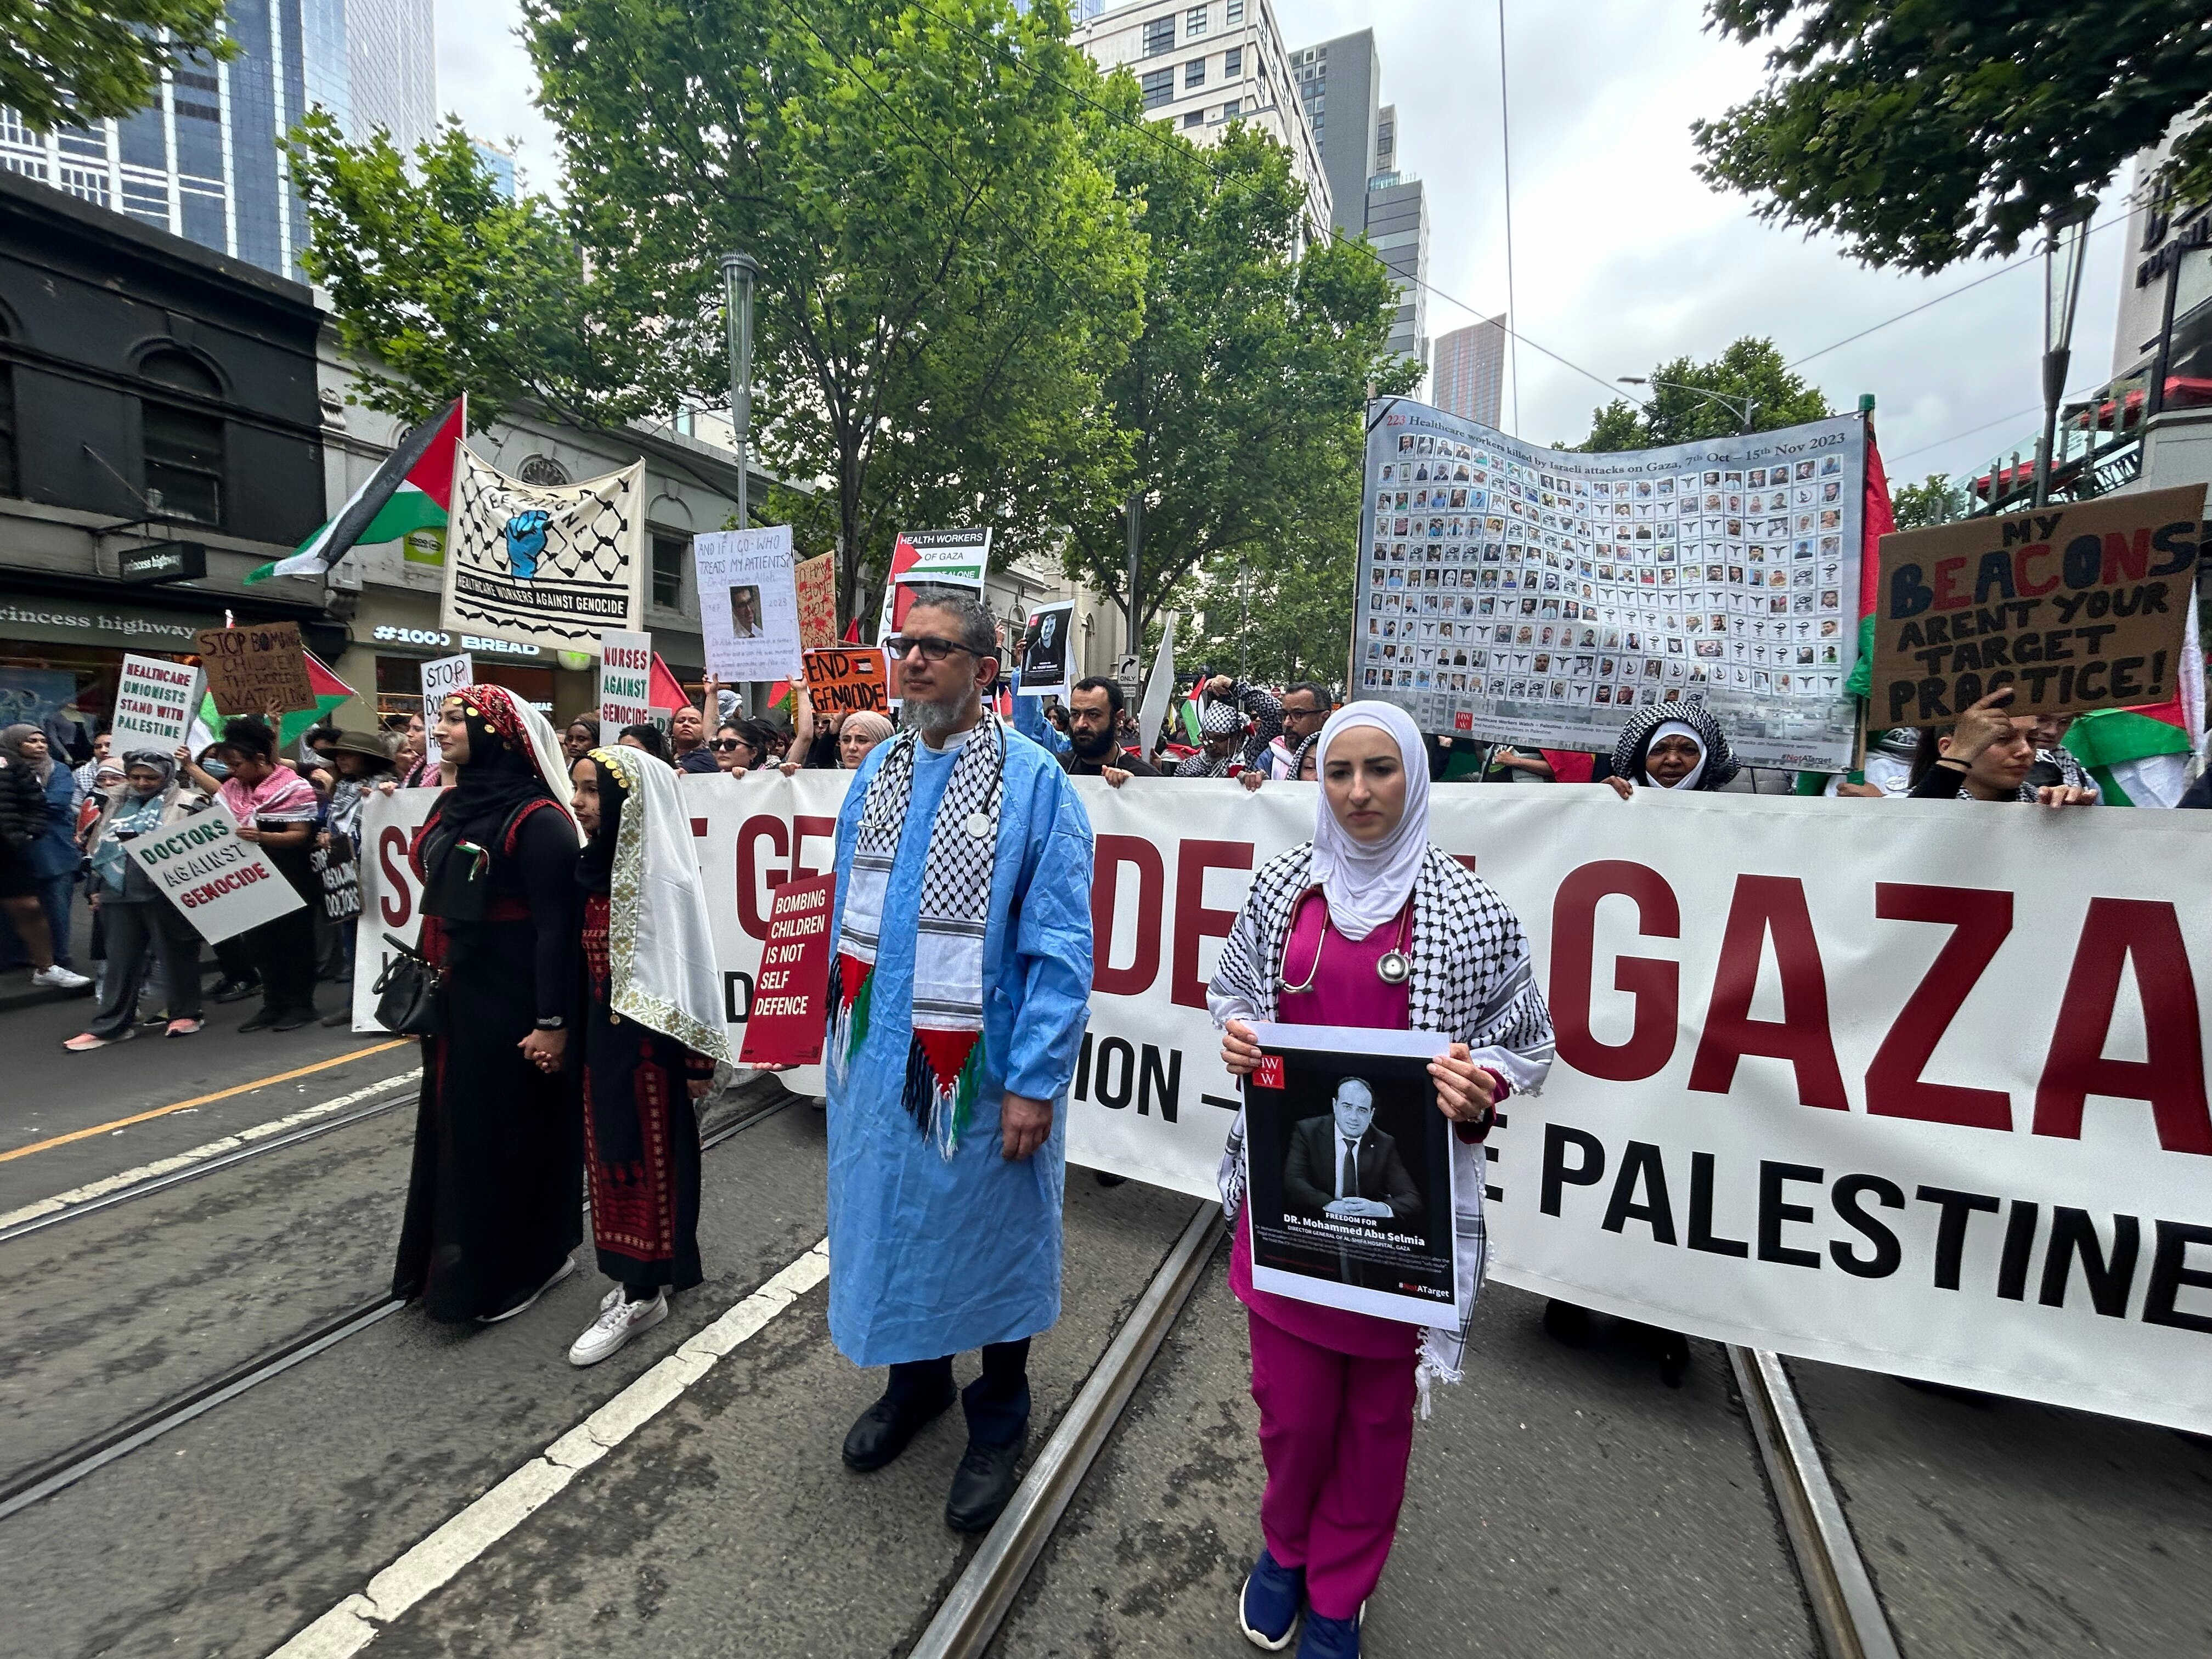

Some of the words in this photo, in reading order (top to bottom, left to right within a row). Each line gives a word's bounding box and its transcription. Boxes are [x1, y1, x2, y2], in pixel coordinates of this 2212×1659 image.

[1386, 415, 1406, 426] 223
[1409, 416, 1465, 437] Healthcare
[1468, 434, 1505, 452] workers
[1507, 447, 1532, 463] killed
[1534, 458, 1546, 469] by
[1550, 461, 1581, 473] Israeli
[1584, 464, 1624, 475] attacks
[1646, 461, 1682, 472] Gaza,
[1685, 455, 1703, 465] 7th
[1707, 453, 1729, 462] Oct
[1746, 448, 1770, 461] 15th
[1774, 443, 1805, 456] Nov
[1809, 432, 1846, 450] 2023
[900, 535, 934, 545] HEALTH
[936, 533, 983, 543] WORKERS
[2002, 513, 2063, 546] MY
[698, 543, 714, 556] AND
[718, 541, 727, 554] IF
[699, 560, 725, 574] TREATS
[730, 558, 743, 572] MY
[744, 552, 792, 571] PATIENTS?
[810, 557, 833, 579] HAVE
[1890, 521, 2196, 619] BEACONS
[457, 574, 498, 597] HEALTHCARE
[495, 585, 534, 604] WORKERS
[536, 592, 573, 610] AGAINST
[575, 596, 624, 615] GENOCIDE
[808, 601, 825, 617] NOT
[1897, 599, 2041, 652] ARENT
[2053, 582, 2169, 624] YOUR
[0, 606, 91, 627] rincess
[97, 615, 196, 640] highway
[200, 632, 246, 656] STOP
[373, 625, 450, 646] #1000
[461, 635, 540, 655] BREAD
[1915, 624, 2116, 676] TARGET
[604, 646, 647, 670] NURSES
[804, 653, 849, 682] END
[126, 663, 191, 686] HEALTHCARE
[427, 660, 465, 688] STOP
[1889, 650, 2167, 723] PRACTICE!
[123, 680, 186, 703] UNIONISTS
[603, 675, 647, 699] AGAINST
[811, 681, 888, 711] GENOCIDE!
[120, 698, 153, 715] STAND
[157, 705, 184, 721] WITH
[602, 703, 648, 725] GENOCIDE
[1475, 716, 1498, 724] Healthcare
[117, 715, 180, 739] PALESTINE
[1781, 754, 1832, 765] #NotATarget
[139, 819, 229, 865] DOCTORS
[162, 841, 247, 888] AGAINST
[179, 861, 270, 909] GENOCIDE
[775, 889, 826, 915] BOMBING
[770, 914, 825, 939] CHILDREN
[765, 946, 778, 964] IS
[779, 943, 805, 963] NOT
[760, 970, 791, 990] SELF
[754, 995, 809, 1015] DEFENCE
[1548, 859, 2212, 1156] GAZA
[1283, 1214, 1301, 1225] DR.
[1303, 1217, 1363, 1236] Mohammed
[1364, 1228, 1386, 1240] Abu
[1387, 1232, 1426, 1247] Selmia
[1325, 1212, 1361, 1224] FREEDOM
[1362, 1218, 1378, 1227] FOR
[1539, 1122, 2212, 1334] PALESTINE
[1288, 1225, 1313, 1235] DIRECTOR
[1313, 1229, 1335, 1239] GENERAL
[1396, 1244, 1410, 1252] GAZA
[1398, 1282, 1450, 1298] #NotATarget
